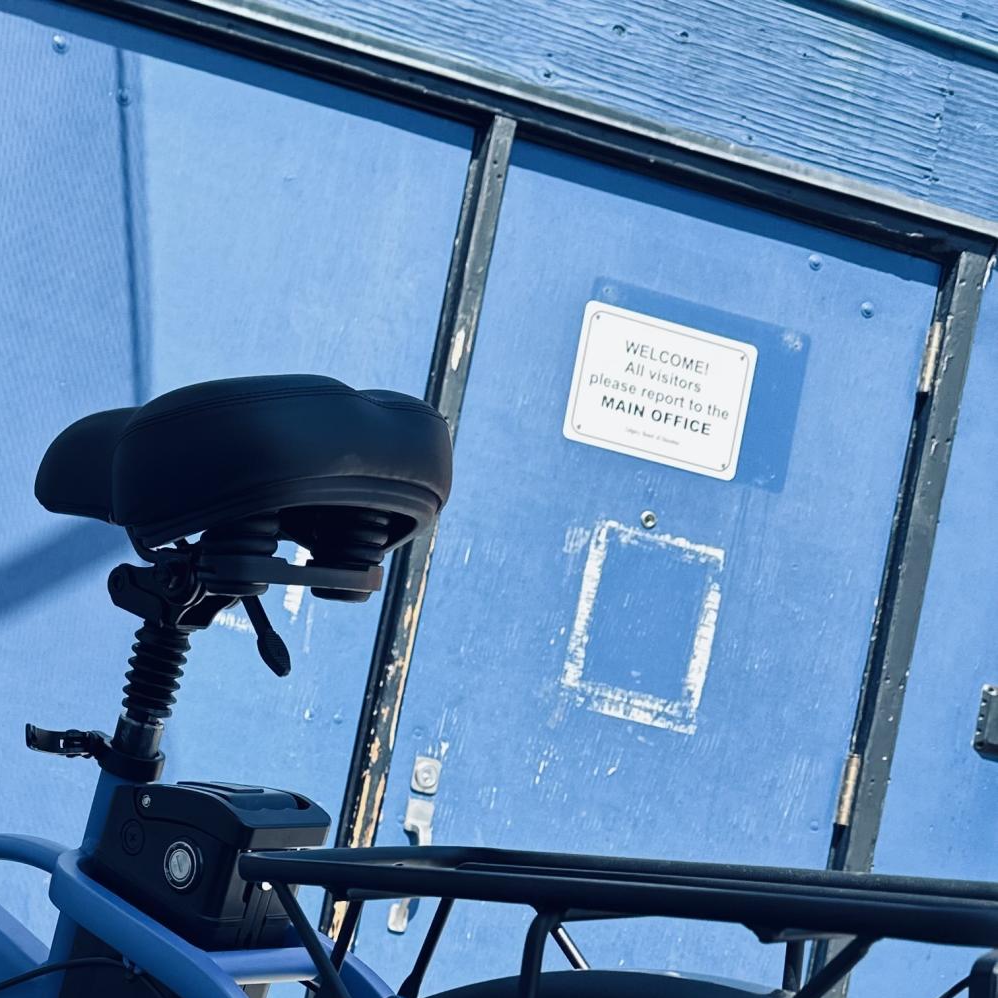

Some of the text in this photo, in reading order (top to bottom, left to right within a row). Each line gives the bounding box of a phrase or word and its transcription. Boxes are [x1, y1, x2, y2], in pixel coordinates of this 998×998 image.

[624, 361, 702, 393] All visitors
[625, 340, 710, 376] WELCOME!
[589, 372, 730, 420] please report to the
[601, 395, 645, 418] MAIN
[651, 409, 712, 436] OFFICE
